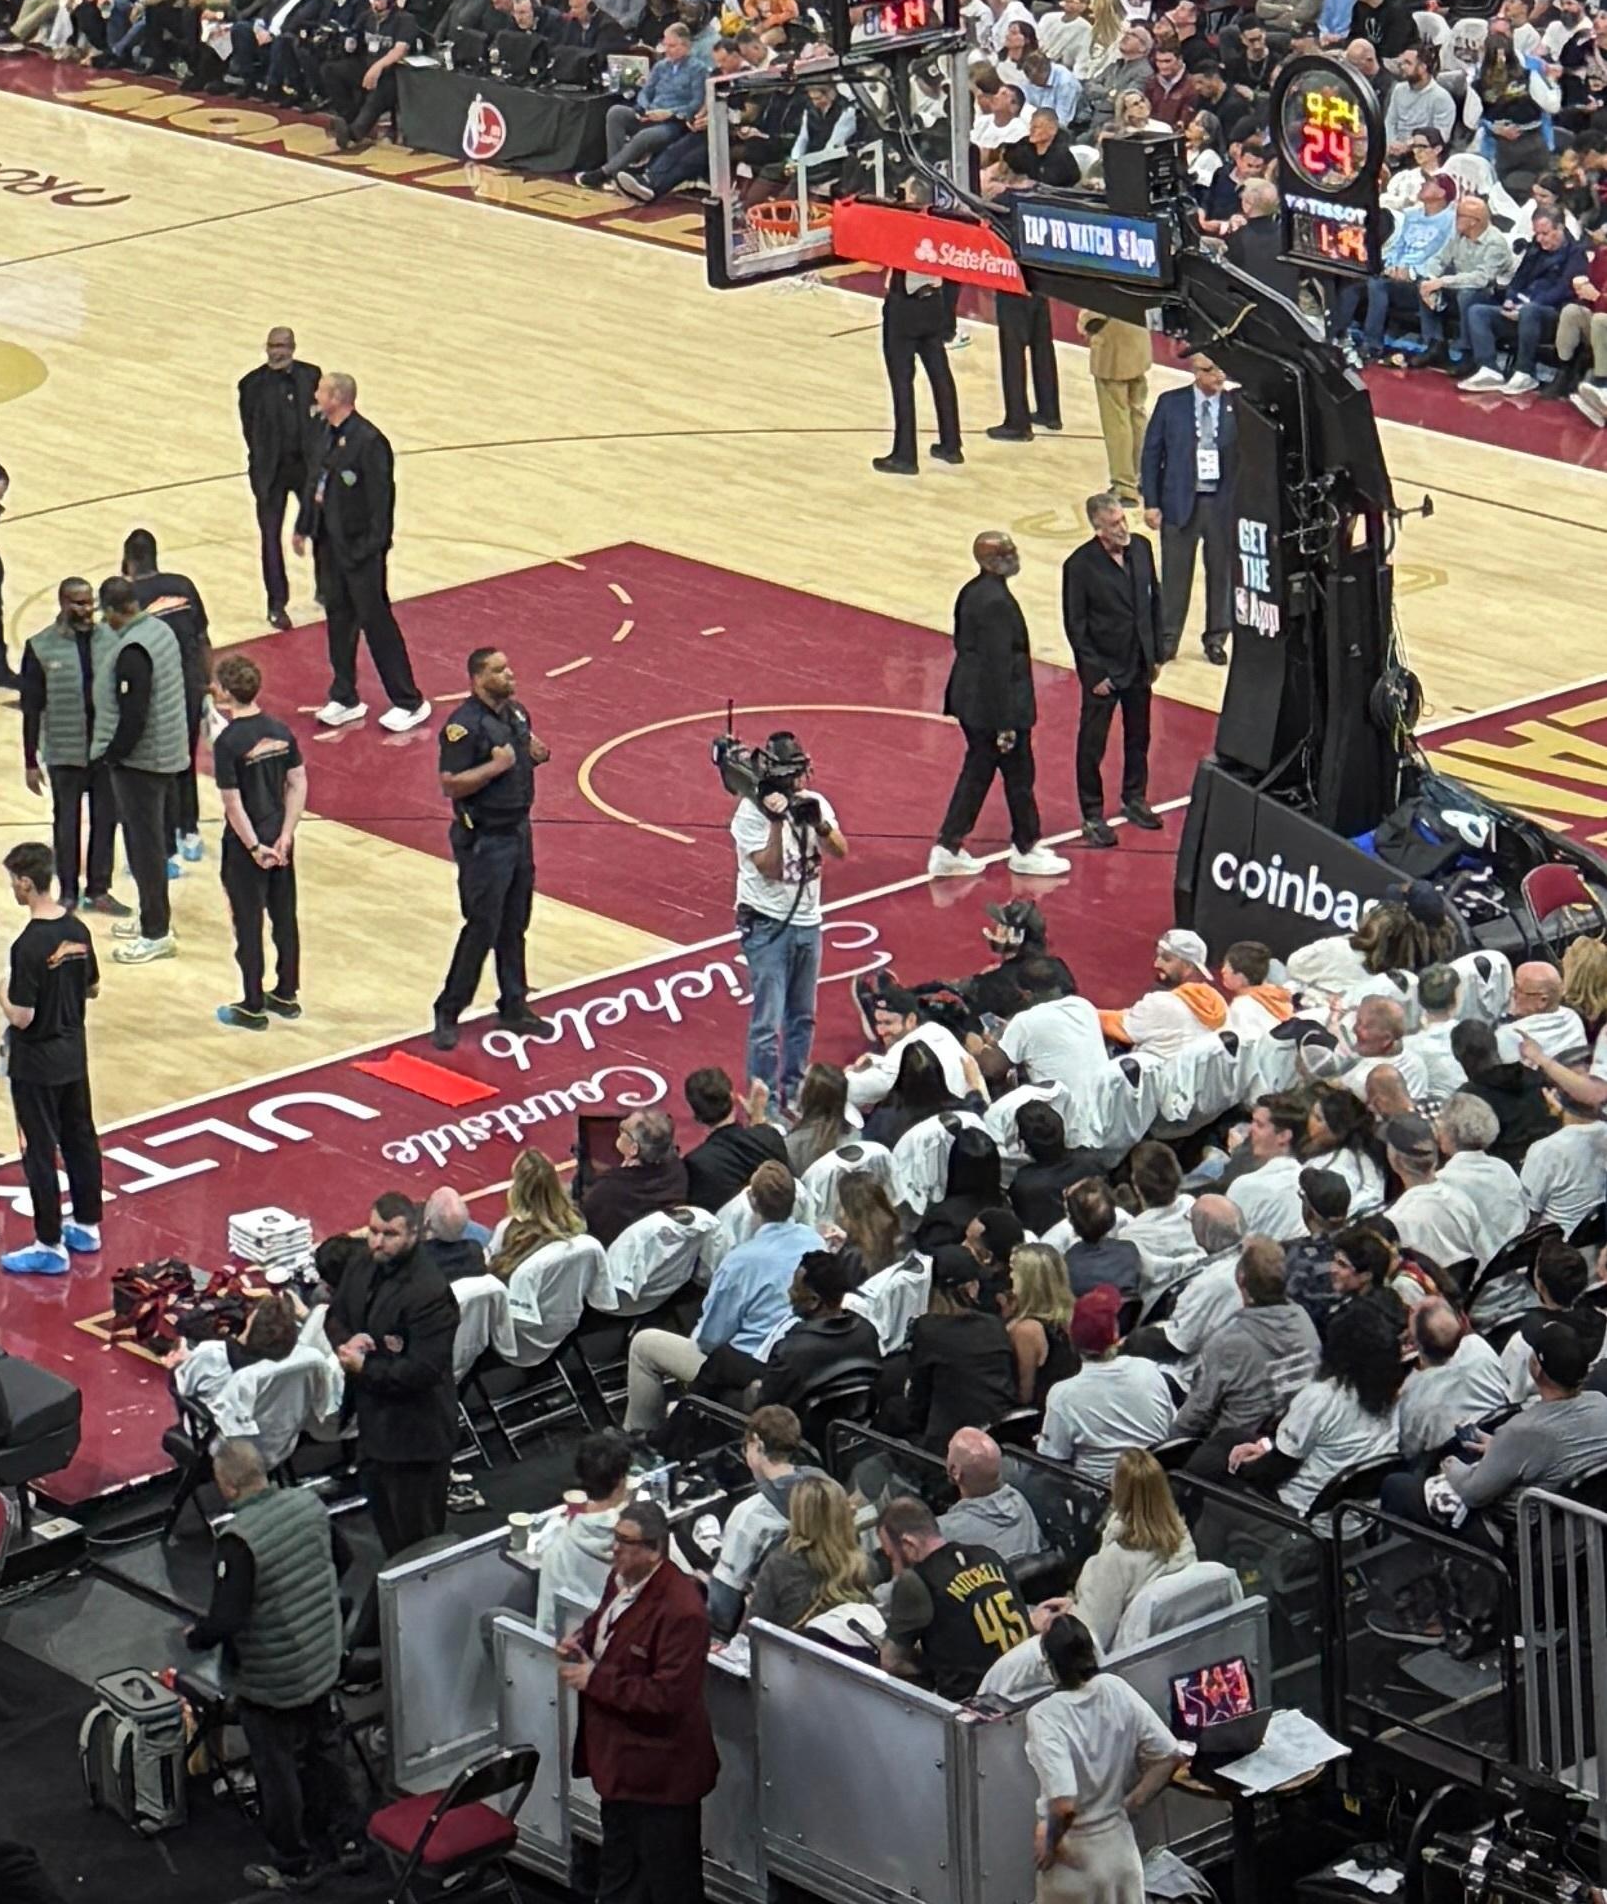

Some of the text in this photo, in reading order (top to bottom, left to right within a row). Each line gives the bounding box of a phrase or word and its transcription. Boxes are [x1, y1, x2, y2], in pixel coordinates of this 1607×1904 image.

[1304, 125, 1352, 176] 24
[1023, 215, 1047, 245] TAP
[1068, 221, 1114, 257] WATCH
[1238, 518, 1267, 555] GET
[1240, 554, 1270, 592] THE
[383, 1065, 667, 1168] Courtside
[947, 1563, 1007, 1603] MITCHELL
[974, 1590, 1029, 1654] 45
